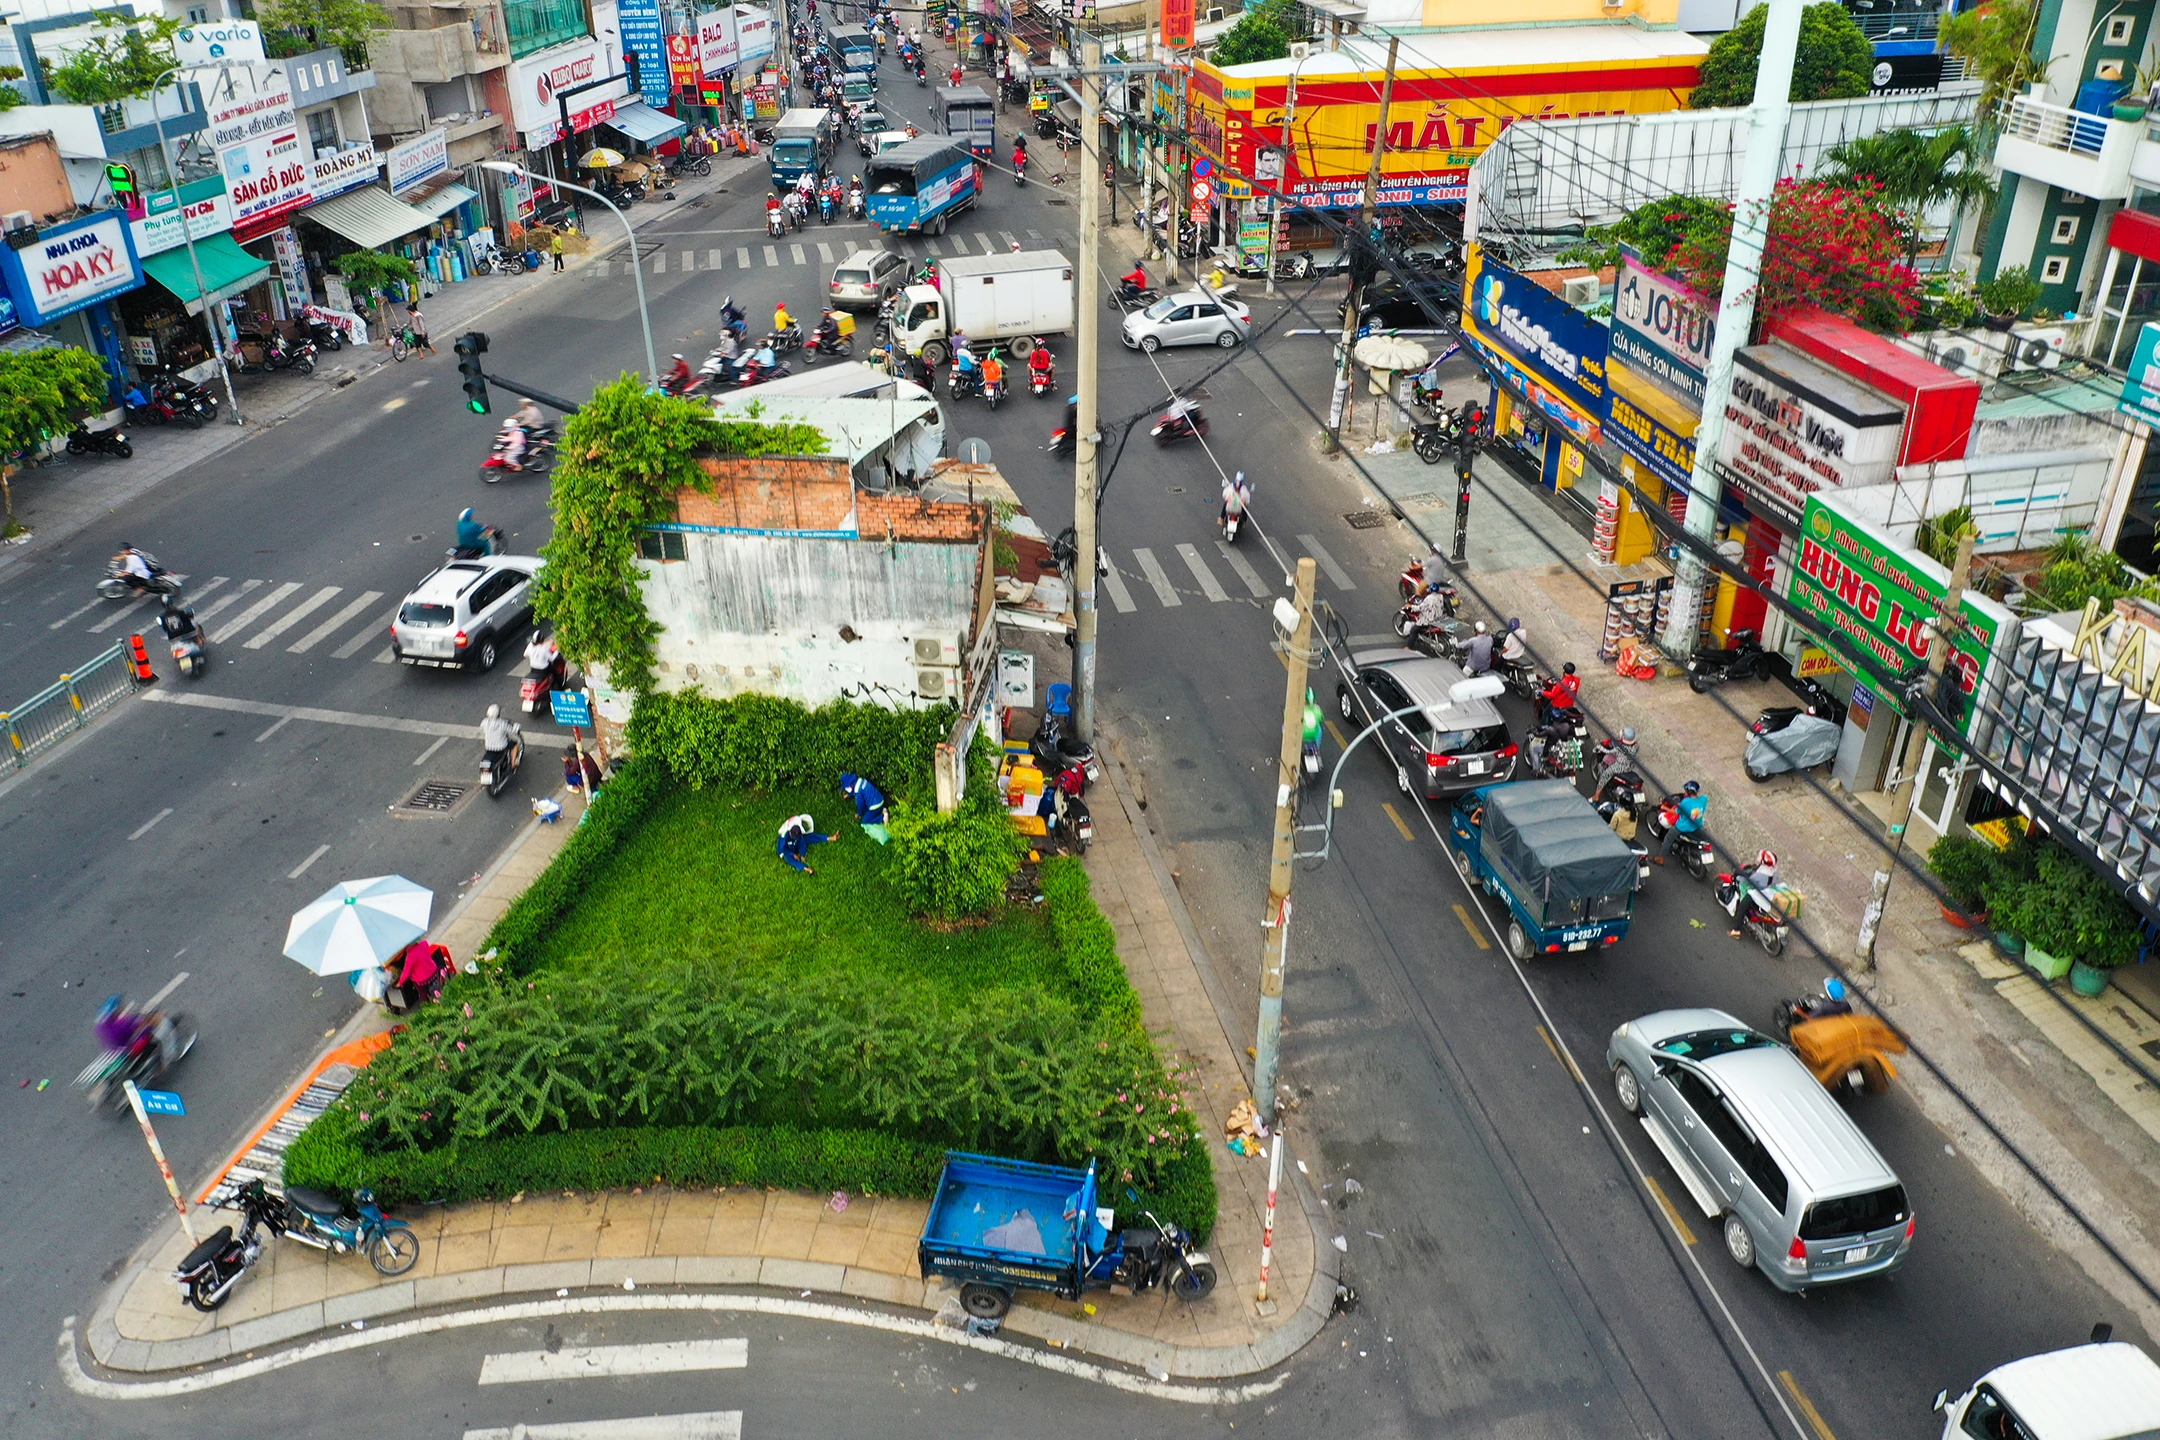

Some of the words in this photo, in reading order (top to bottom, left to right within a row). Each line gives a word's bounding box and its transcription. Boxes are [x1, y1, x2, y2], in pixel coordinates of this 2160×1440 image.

[200, 27, 251, 42] vario
[702, 23, 722, 45] BALO
[552, 66, 571, 88] BIBO
[572, 60, 592, 80] MART
[1364, 104, 1485, 154] MẮT
[314, 153, 355, 178] HOÀNG
[399, 150, 420, 172] SƠN
[422, 141, 445, 160] NAM
[233, 178, 258, 205] SÀN
[260, 166, 278, 195] GỖ
[280, 160, 305, 188] ĐỨC
[1294, 182, 1307, 193] HỆ
[1310, 178, 1342, 192] THỐNG
[1344, 178, 1366, 189] BÁN
[1381, 176, 1421, 188] CHUYÊN
[1421, 173, 1460, 185] NGHIỆP
[1334, 194, 1364, 207] HỌ
[1374, 190, 1412, 203] SINH
[1427, 187, 1467, 200] SINH
[144, 220, 161, 233] Phụ
[163, 213, 182, 226] tùng
[46, 242, 70, 260] NHA
[70, 232, 99, 252] KHOA
[42, 260, 88, 295] HOA
[86, 245, 114, 278] KỲ
[1613, 330, 1628, 354] CỬA
[1630, 342, 1651, 367] HÀNG
[1653, 356, 1669, 378] SƠN
[1670, 366, 1692, 393] MINH
[1610, 397, 1652, 444] MINH
[1834, 528, 1859, 556] CÔNG
[1861, 546, 1872, 562] TY
[1872, 556, 1888, 574] CỔ
[1888, 569, 1915, 593] PHẦN
[1796, 579, 1810, 598] UY
[1811, 590, 1828, 614] TÍN
[1834, 607, 1868, 645] TRÁCH
[1869, 637, 1904, 672] NHIỆM
[1798, 536, 1881, 622] HÙNG
[1885, 600, 1980, 695] LOG
[2071, 596, 2160, 703] KA
